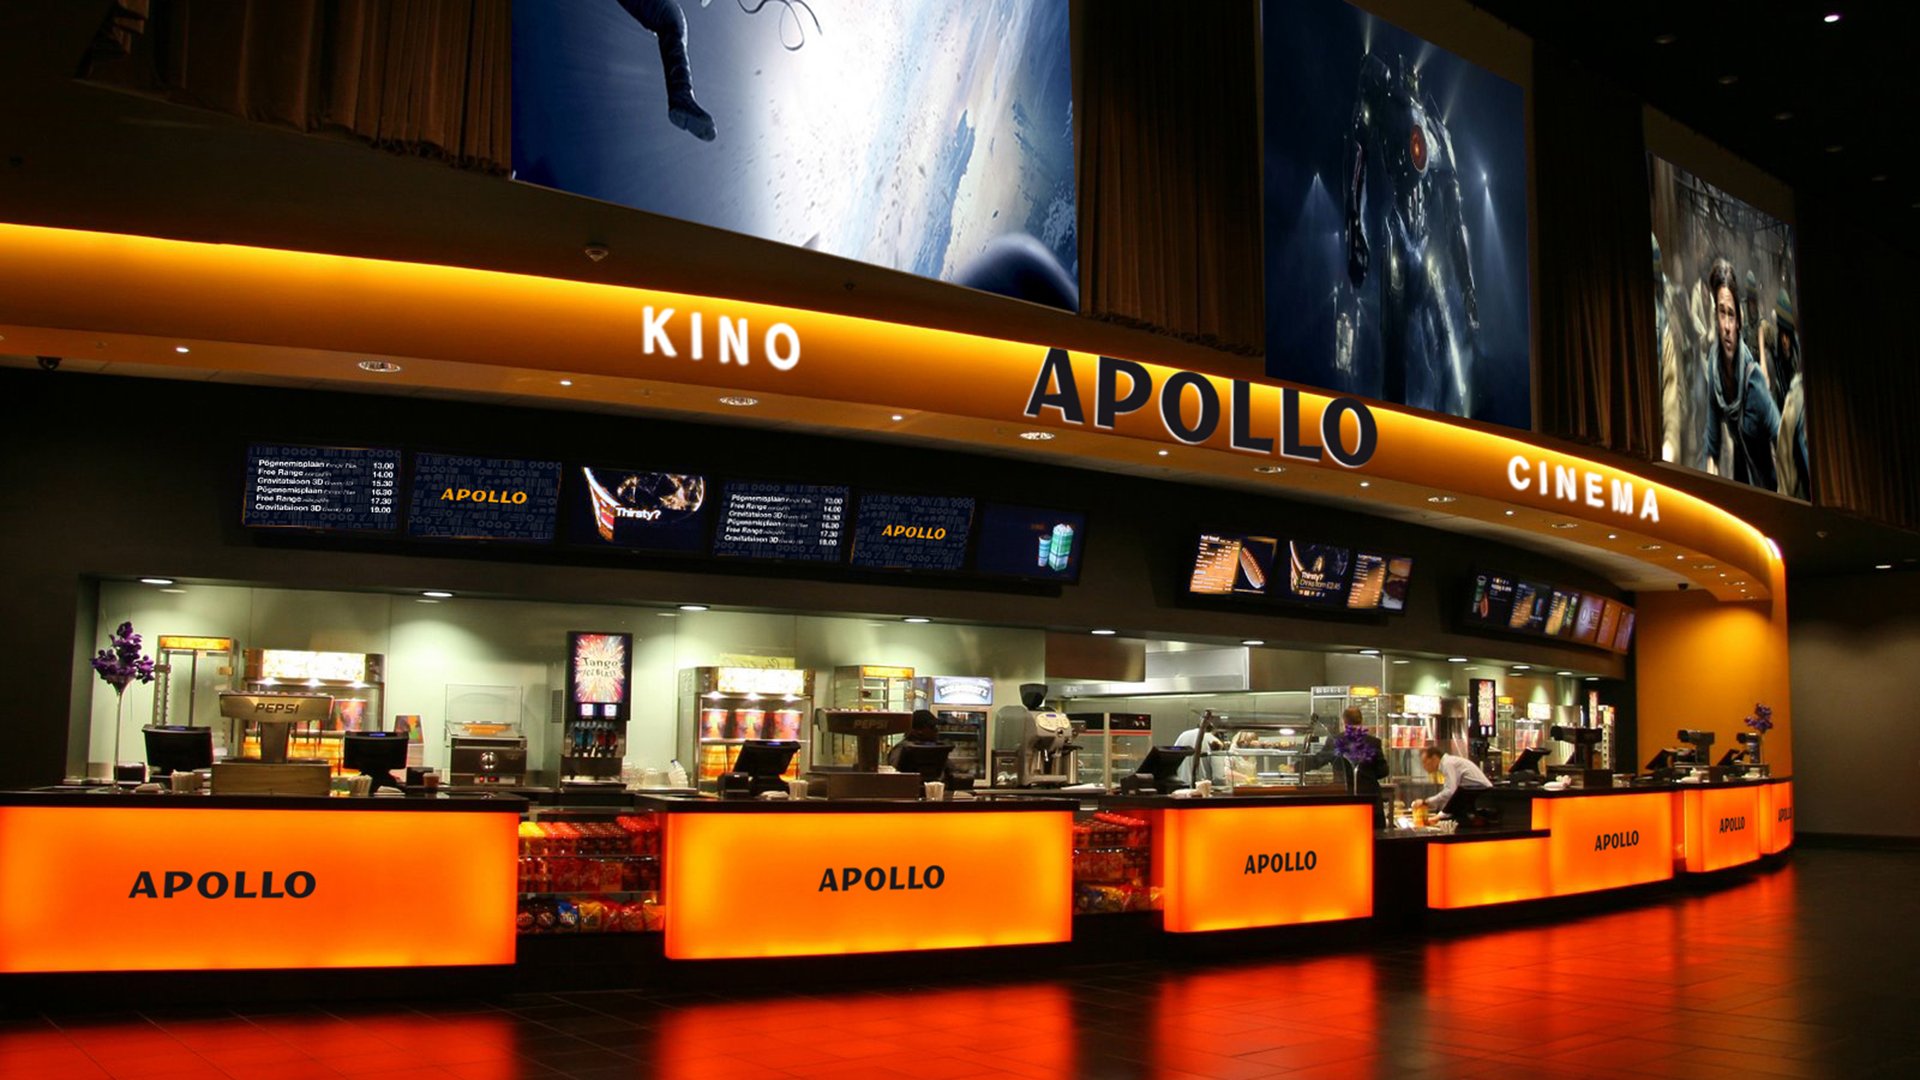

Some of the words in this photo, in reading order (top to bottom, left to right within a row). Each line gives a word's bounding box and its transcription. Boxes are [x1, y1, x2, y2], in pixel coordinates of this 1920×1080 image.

[642, 305, 801, 371] KINO
[1024, 347, 1378, 468] APOLLO
[257, 467, 276, 475] Free
[277, 468, 304, 477] Range
[371, 488, 393, 496] 16.30
[440, 488, 527, 504] APOLLO
[1507, 455, 1660, 523] CINEMA
[276, 494, 302, 503] Range
[370, 497, 392, 505] 17.30
[310, 504, 322, 512] 3D
[615, 507, 661, 521] Thirsty?
[746, 502, 767, 511] Range
[824, 505, 842, 513] 14.00
[881, 524, 947, 540] APOLLO
[1302, 571, 1324, 582] Thirsty?
[581, 656, 618, 670] Tango
[255, 702, 300, 715] PEPSI
[853, 719, 889, 730] PEPSI
[1719, 816, 1745, 834] APOLLO
[1594, 830, 1640, 852] APOLLO
[1244, 850, 1317, 875] APOLLO
[128, 870, 316, 899] APOLLO
[818, 865, 945, 892] APOLLO
